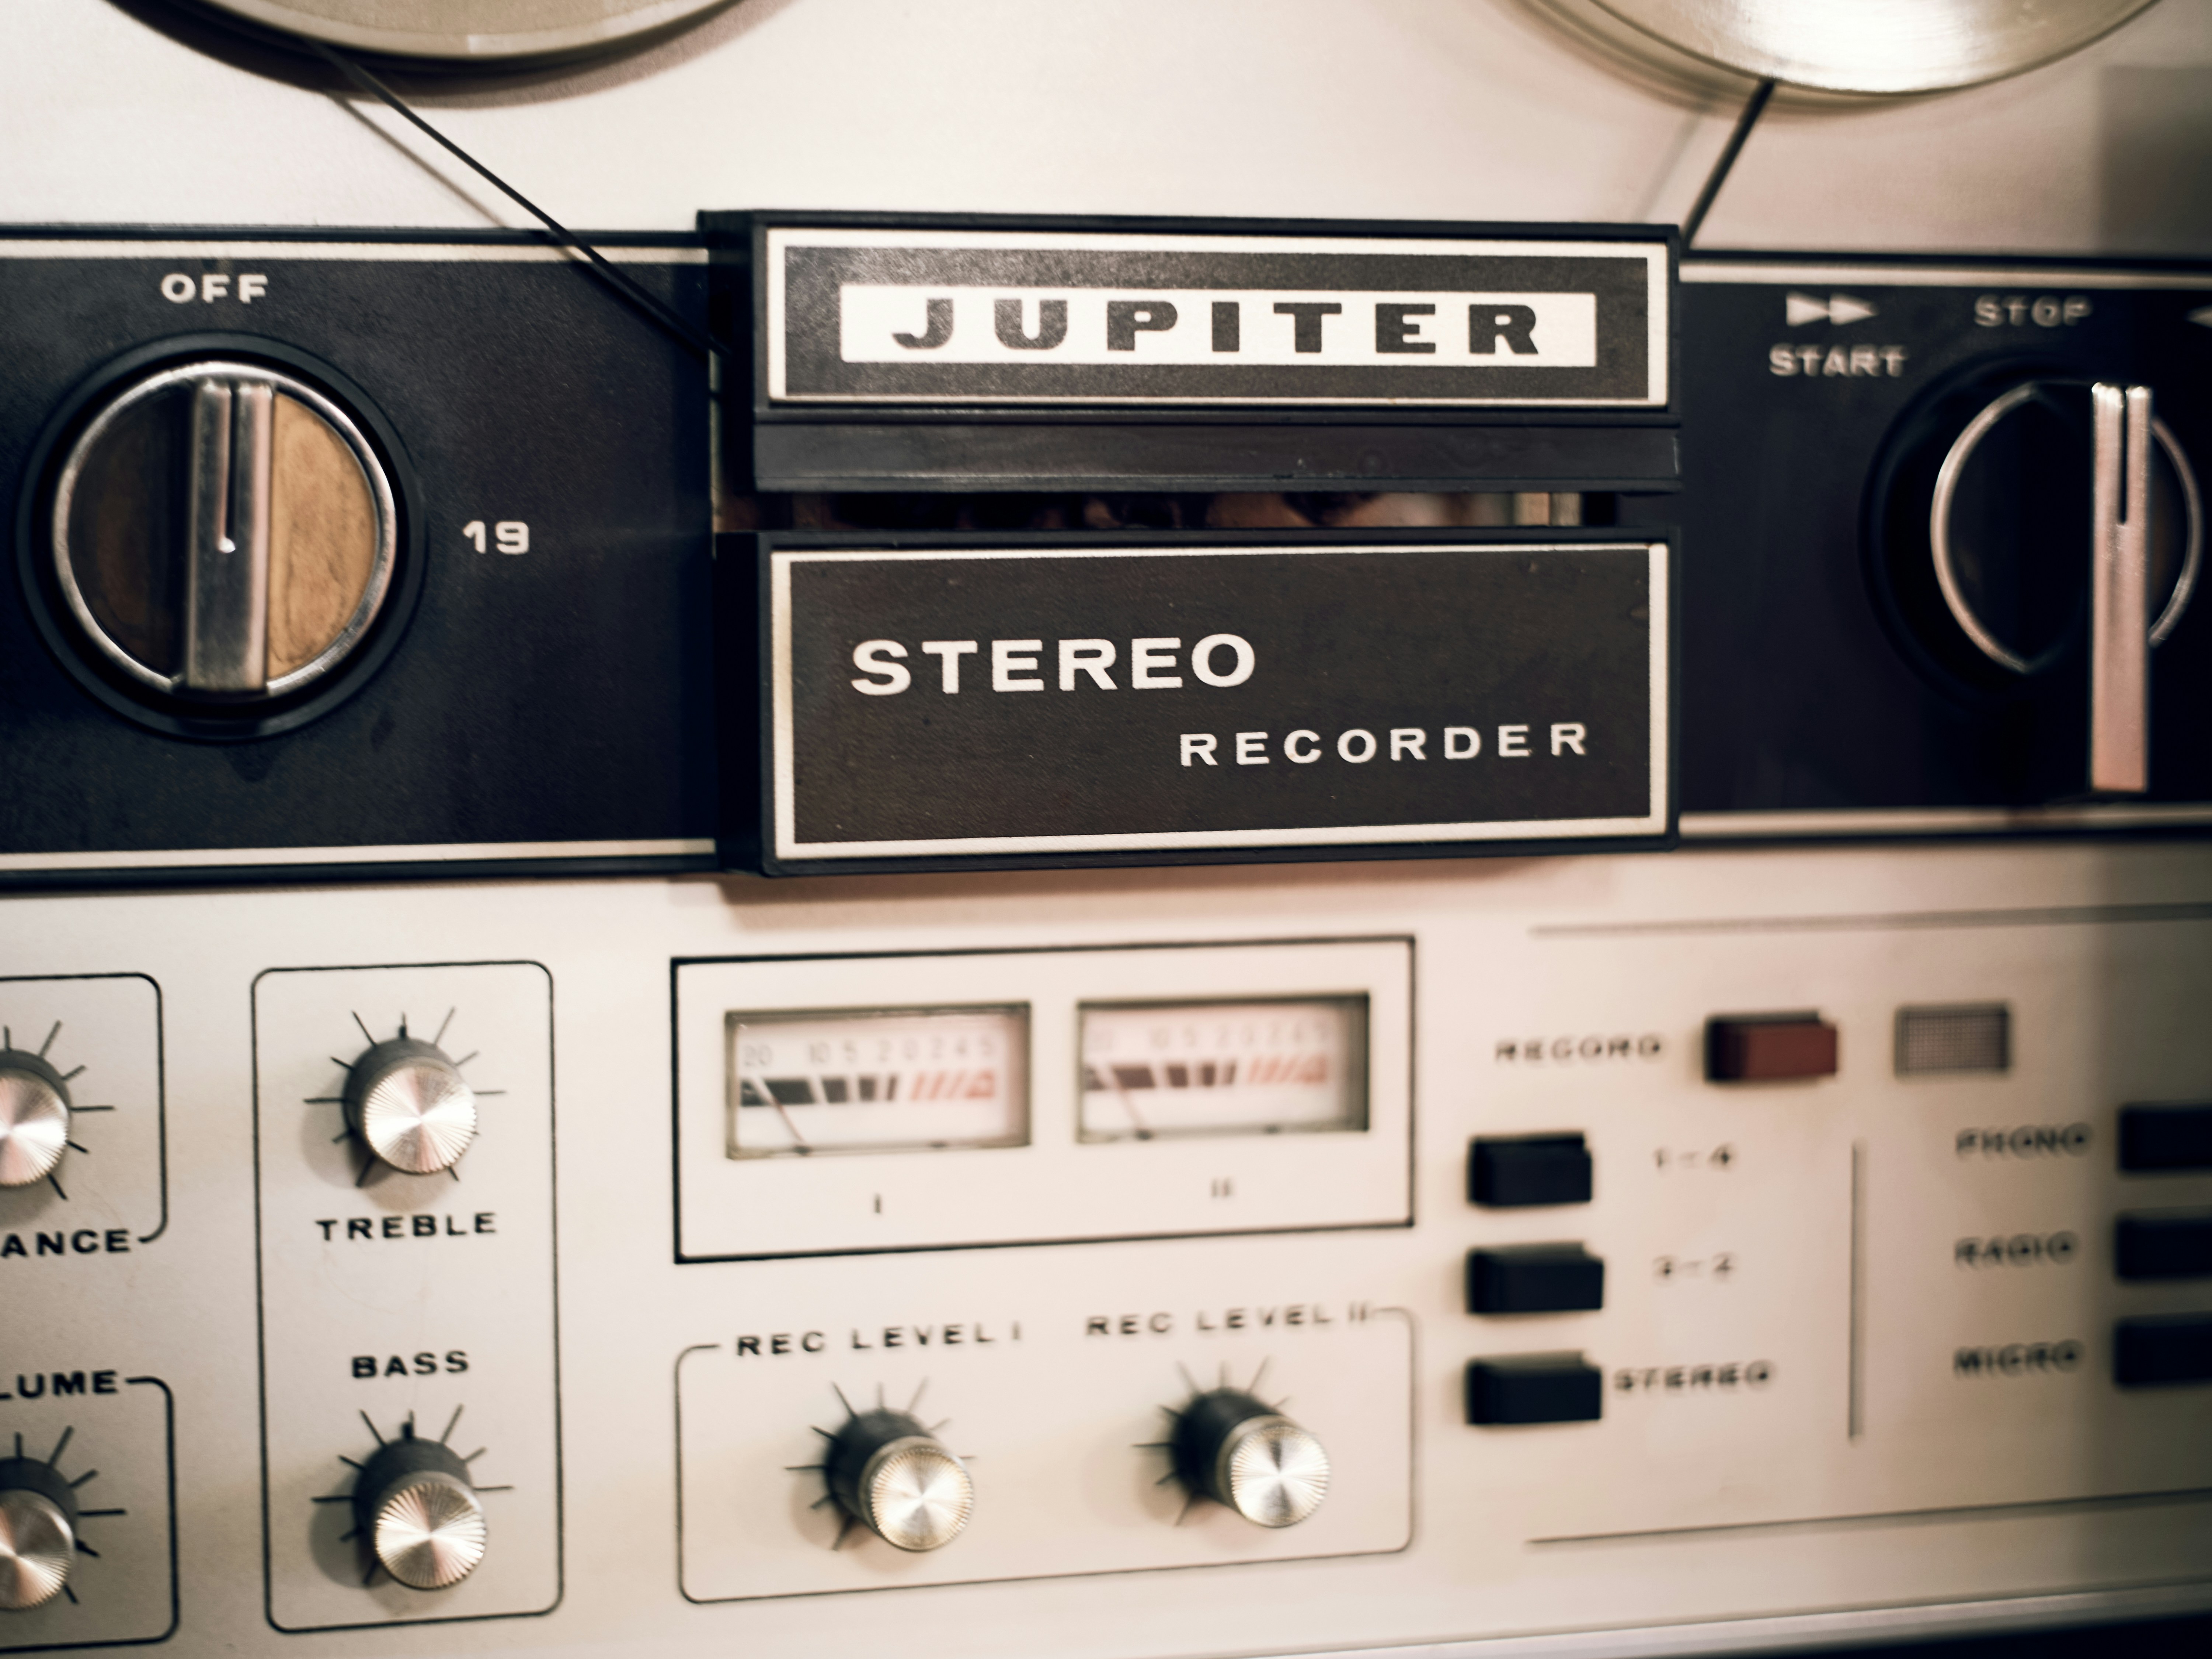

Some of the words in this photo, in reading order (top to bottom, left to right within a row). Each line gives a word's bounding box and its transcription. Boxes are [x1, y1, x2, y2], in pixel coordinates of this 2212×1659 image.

[160, 272, 269, 304] OFF
[891, 298, 1540, 356] JUPITER
[1973, 296, 2091, 328] STOP
[1769, 344, 1907, 377] START
[462, 520, 530, 555] 19
[850, 632, 1256, 697] STEREO
[1179, 721, 1587, 768] RECORDER
[1493, 1035, 1666, 1062] RECORD
[315, 1211, 497, 1242] TREBLE
[0, 1229, 131, 1259] ANCE
[1086, 1314, 1171, 1336] REC
[1196, 1304, 1333, 1332] LEVEL
[736, 1331, 825, 1357] REC
[851, 1324, 994, 1351] LEVEL
[350, 1350, 470, 1380] BASS
[1614, 1360, 1774, 1393] STEREO
